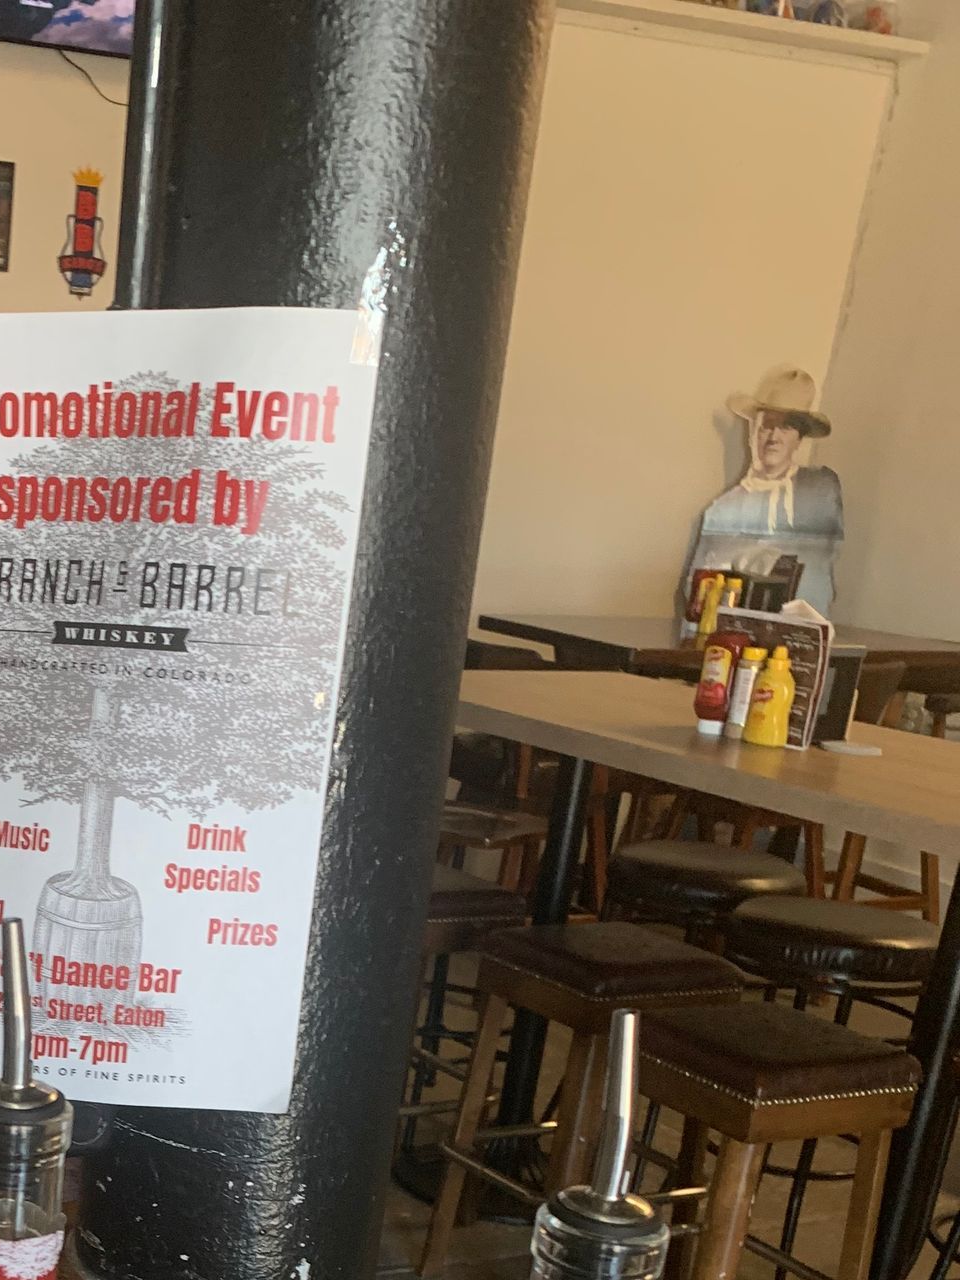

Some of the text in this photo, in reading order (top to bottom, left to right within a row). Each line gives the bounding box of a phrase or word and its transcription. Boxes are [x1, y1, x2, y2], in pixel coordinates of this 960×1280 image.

[211, 381, 340, 444] Event
[213, 470, 270, 536] by
[139, 562, 304, 618] BARREL
[64, 626, 176, 647] WHISKEY
[114, 664, 132, 676] IN
[142, 666, 253, 686] COLORADO
[187, 823, 247, 853] Drink
[164, 863, 261, 894] Specials
[207, 918, 279, 948] Prizes
[51, 955, 131, 991] Dance
[138, 962, 183, 994] Bar
[47, 998, 108, 1027] Street,
[113, 1004, 166, 1028] Eaton
[31, 1034, 128, 1066] pm-7pm
[58, 1067, 77, 1077] OF
[85, 1070, 119, 1082] FINE
[127, 1073, 186, 1085] SPIRITS
